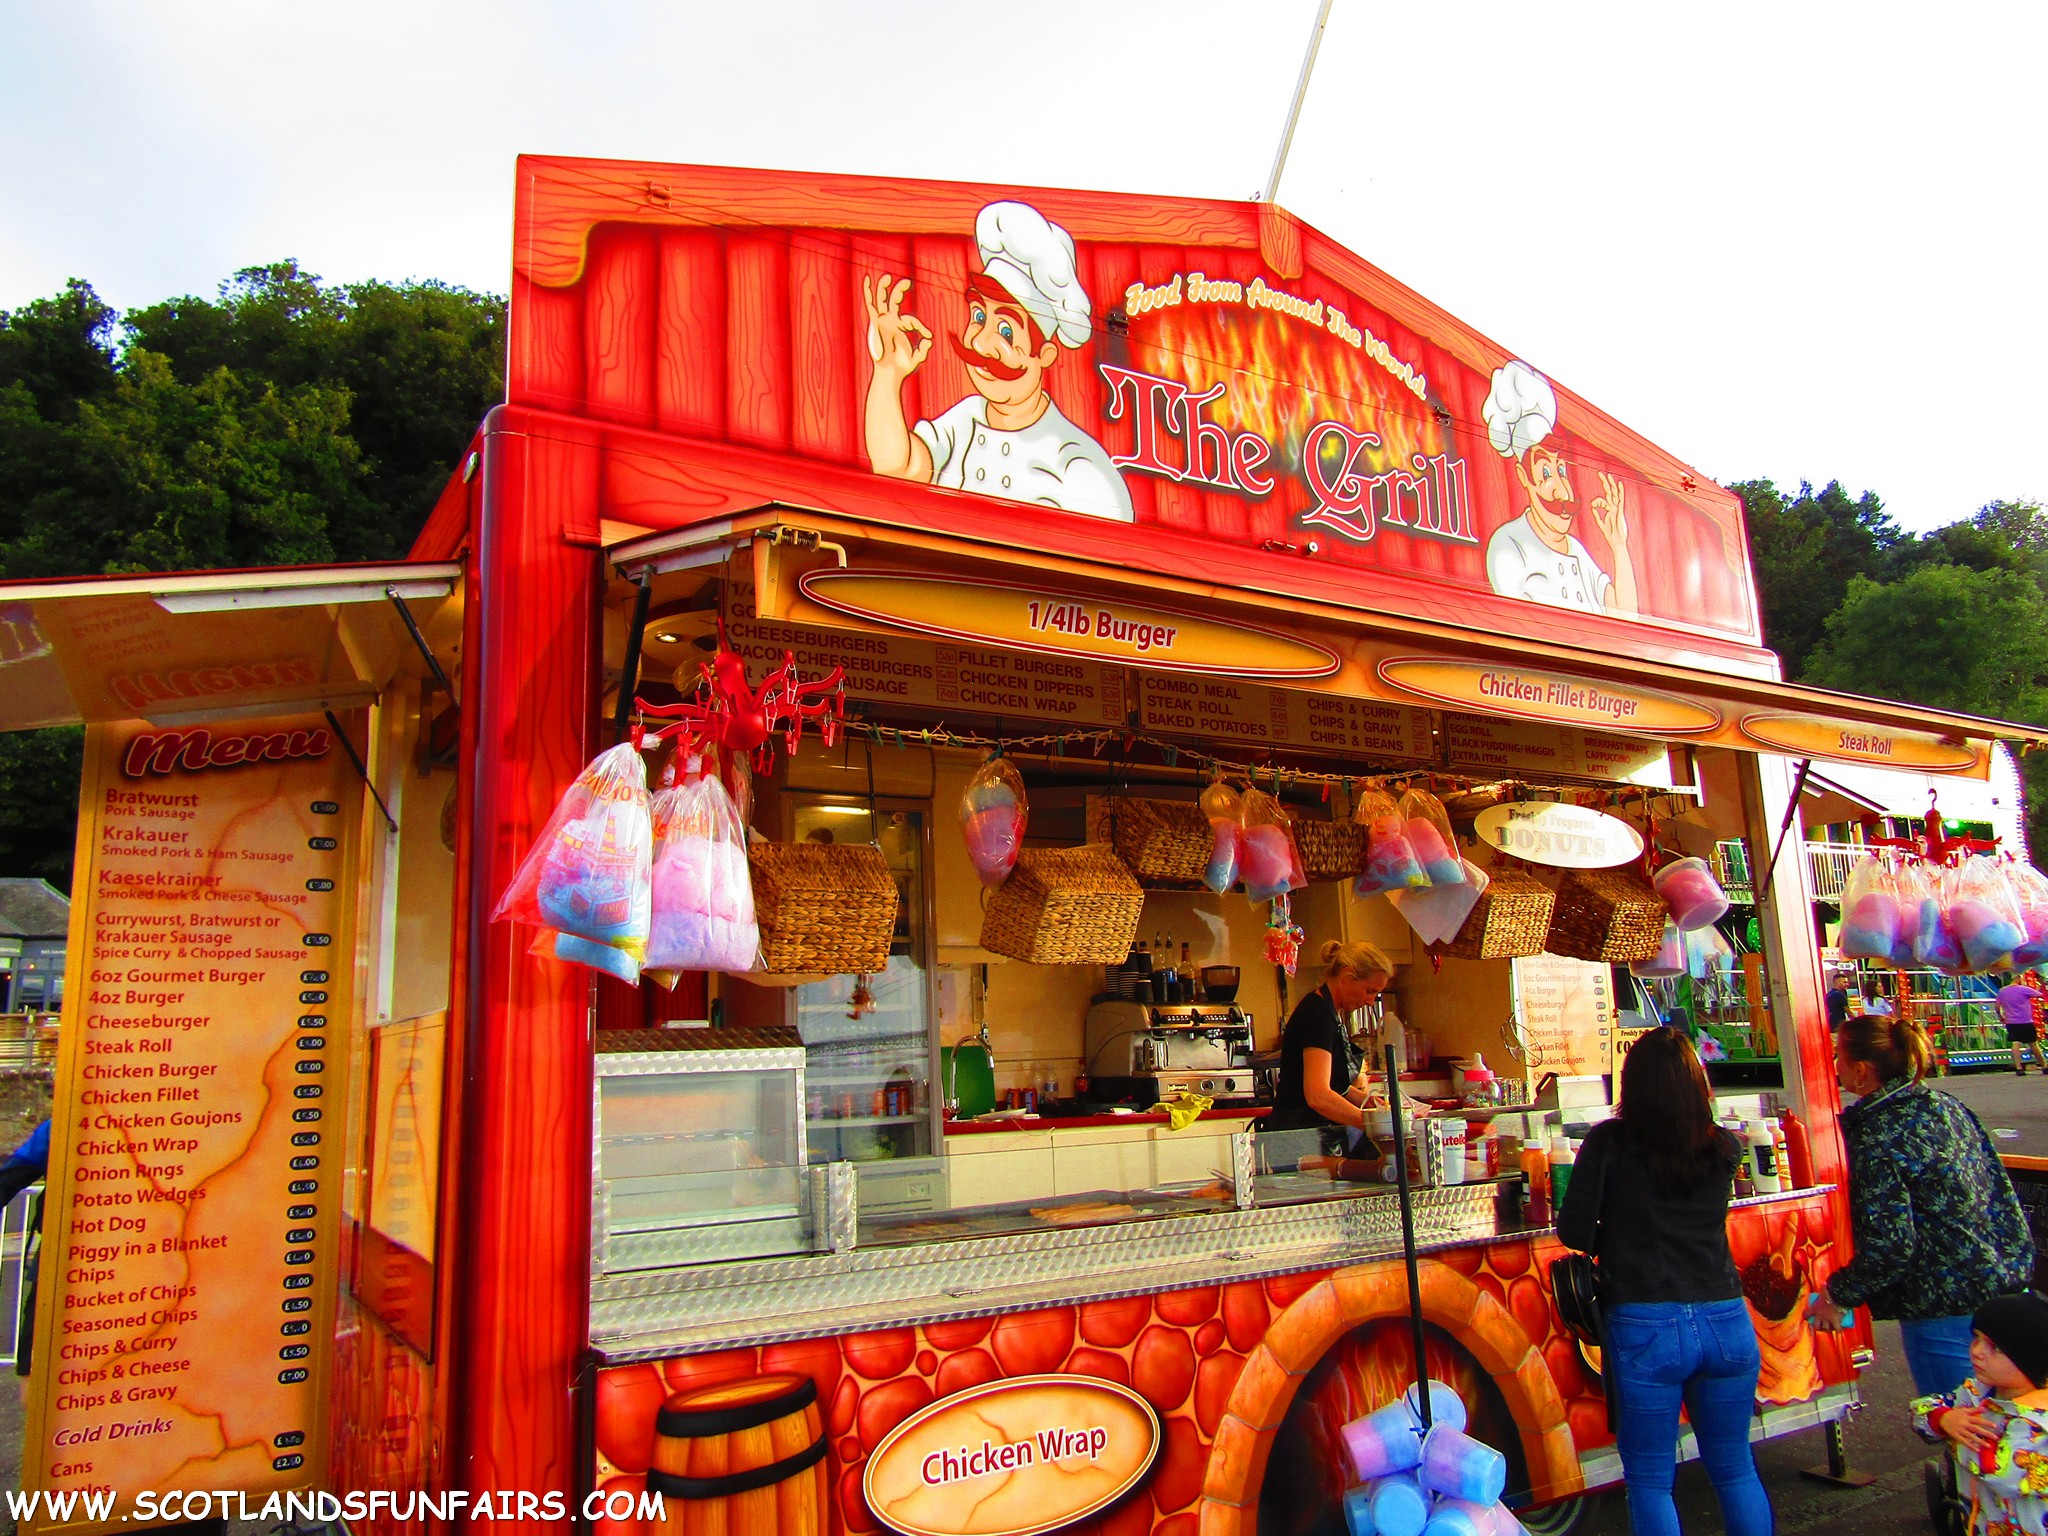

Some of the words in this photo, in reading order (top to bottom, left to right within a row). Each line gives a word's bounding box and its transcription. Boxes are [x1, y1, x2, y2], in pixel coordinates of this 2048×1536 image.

[1126, 274, 1181, 316] Food
[1188, 272, 1242, 302] From
[1246, 277, 1324, 325] Around
[1326, 306, 1362, 348] The
[1365, 329, 1427, 401] World
[1099, 364, 1274, 494] The
[1302, 421, 1478, 542] Grill
[1028, 602, 1091, 635] 1/4lb
[1096, 611, 1177, 651] Burger
[731, 623, 888, 655] CHEESEBURGERS
[733, 643, 786, 662] BACON
[796, 651, 932, 679] CHEESEBURGERS
[959, 651, 1008, 668] FILLET
[1014, 658, 1084, 679] BURGERS
[840, 676, 908, 695] AUSAGE
[959, 670, 1028, 689] CHICKEN
[1034, 679, 1094, 698] DIPPERS
[1146, 677, 1199, 694] COMBO
[1204, 684, 1241, 700] MEAL
[960, 688, 1028, 709] CHICKEN
[1034, 697, 1077, 713] WRAP
[1478, 671, 1543, 702] Chicken
[1545, 681, 1585, 709] Fillet
[1587, 687, 1639, 719] Burger
[1147, 695, 1193, 711] STEAK
[1199, 701, 1234, 716] ROLL
[1308, 698, 1344, 713] CHIPS
[1349, 703, 1357, 715] &
[1362, 705, 1401, 720] CURRY
[1148, 712, 1195, 728] BAKED
[1201, 718, 1267, 737] POTATOES
[1309, 714, 1345, 729] CHIPS
[1350, 719, 1358, 730] &
[1364, 721, 1401, 735] GRAVY
[1450, 723, 1469, 734] EGG
[1470, 726, 1491, 737] ROLL
[1311, 730, 1346, 745] CHIPS
[1352, 735, 1360, 746] &
[1365, 737, 1404, 752] BEANS
[1451, 737, 1479, 749] BLACK
[1525, 745, 1555, 757] HAGGIS
[1584, 737, 1623, 750] BREAKFAST
[1624, 743, 1648, 754] WRAPS
[1838, 731, 1867, 751] Steak
[1871, 735, 1892, 755] Roll
[126, 730, 331, 777] Menu
[1453, 751, 1480, 762] EXTRA
[1482, 754, 1508, 764] ITEMS
[1586, 750, 1631, 763] CAPPUCCINO
[1587, 764, 1609, 775] LATTE
[106, 788, 198, 809] Bratwurst
[105, 805, 135, 818] Pork
[139, 807, 196, 821] Sausage
[102, 826, 189, 844] Krakauer
[1496, 826, 1606, 858] DONUTS
[102, 845, 158, 859] Smoked
[161, 846, 191, 860] Pork
[194, 849, 205, 860] &
[208, 849, 238, 861] Ham
[241, 851, 294, 864] Sausage
[99, 869, 222, 888] Kaesekrainer
[97, 888, 153, 901] Smoked
[157, 889, 188, 902] Pork
[190, 891, 202, 902] &
[205, 890, 256, 904] Cheese
[258, 892, 307, 906] Sausage
[95, 911, 186, 929] Currywurst,
[190, 912, 262, 928] Bratwurst
[265, 917, 280, 928] or
[95, 929, 166, 945] Krakauer
[170, 930, 232, 947] Sausage
[92, 946, 130, 961] Spice
[133, 947, 171, 961] Curry
[178, 948, 189, 960] &
[191, 946, 252, 962] Chopped
[254, 948, 308, 963] Sausage
[91, 969, 122, 984] 6oz
[126, 969, 206, 984] Gourmet
[208, 968, 265, 987] Burger
[1562, 974, 1581, 984] Burger
[89, 990, 121, 1005] 4oz
[125, 990, 185, 1008] Burger
[1536, 986, 1556, 996] Burger
[87, 1012, 210, 1033] Cheeseburger
[1527, 1014, 1543, 1023] Steak
[1545, 1014, 1557, 1023] Roll
[1530, 1028, 1552, 1037] Chicken
[1553, 1028, 1573, 1038] Burger
[85, 1039, 133, 1055] Steak
[139, 1037, 172, 1053] Roll
[1555, 1042, 1570, 1050] Fillet
[82, 1063, 153, 1080] Chicken
[160, 1062, 217, 1080] Burger
[1562, 1056, 1585, 1066] Goujons
[81, 1088, 151, 1106] Chicken
[157, 1086, 199, 1103] Fillet
[78, 1116, 90, 1130] 4
[94, 1113, 168, 1131] Chicken
[171, 1109, 242, 1128] Goujons
[76, 1139, 148, 1157] Chicken
[153, 1138, 198, 1155] Wrap
[75, 1165, 130, 1182] Onion
[135, 1163, 184, 1181] Rings
[72, 1191, 133, 1208] Potato
[137, 1186, 207, 1207] Wedges
[70, 1218, 105, 1235] Hot
[109, 1216, 147, 1234] Dog
[68, 1243, 120, 1263] Piggy
[125, 1240, 142, 1257] in
[146, 1244, 156, 1255] a
[163, 1234, 228, 1253] Blanket
[66, 1267, 115, 1285] Chips
[65, 1290, 125, 1309] Bucket
[130, 1286, 147, 1303] of
[150, 1282, 197, 1300] Chips
[62, 1312, 146, 1335] Seasoned
[151, 1307, 198, 1325] Chips
[60, 1341, 111, 1360] Chips
[114, 1340, 126, 1354] &
[131, 1335, 178, 1355] Curry
[58, 1367, 107, 1387] Chips
[111, 1365, 124, 1379] &
[128, 1357, 190, 1376] Cheese
[56, 1394, 105, 1413] Chips
[109, 1390, 123, 1404] &
[126, 1383, 178, 1405] Gravy
[54, 1425, 102, 1448] Cold
[108, 1417, 173, 1440] Drinks
[276, 1456, 301, 1469] £2.0
[922, 1441, 1032, 1486] Chicken
[1038, 1427, 1107, 1461] Wrap
[50, 1461, 93, 1479] Cans
